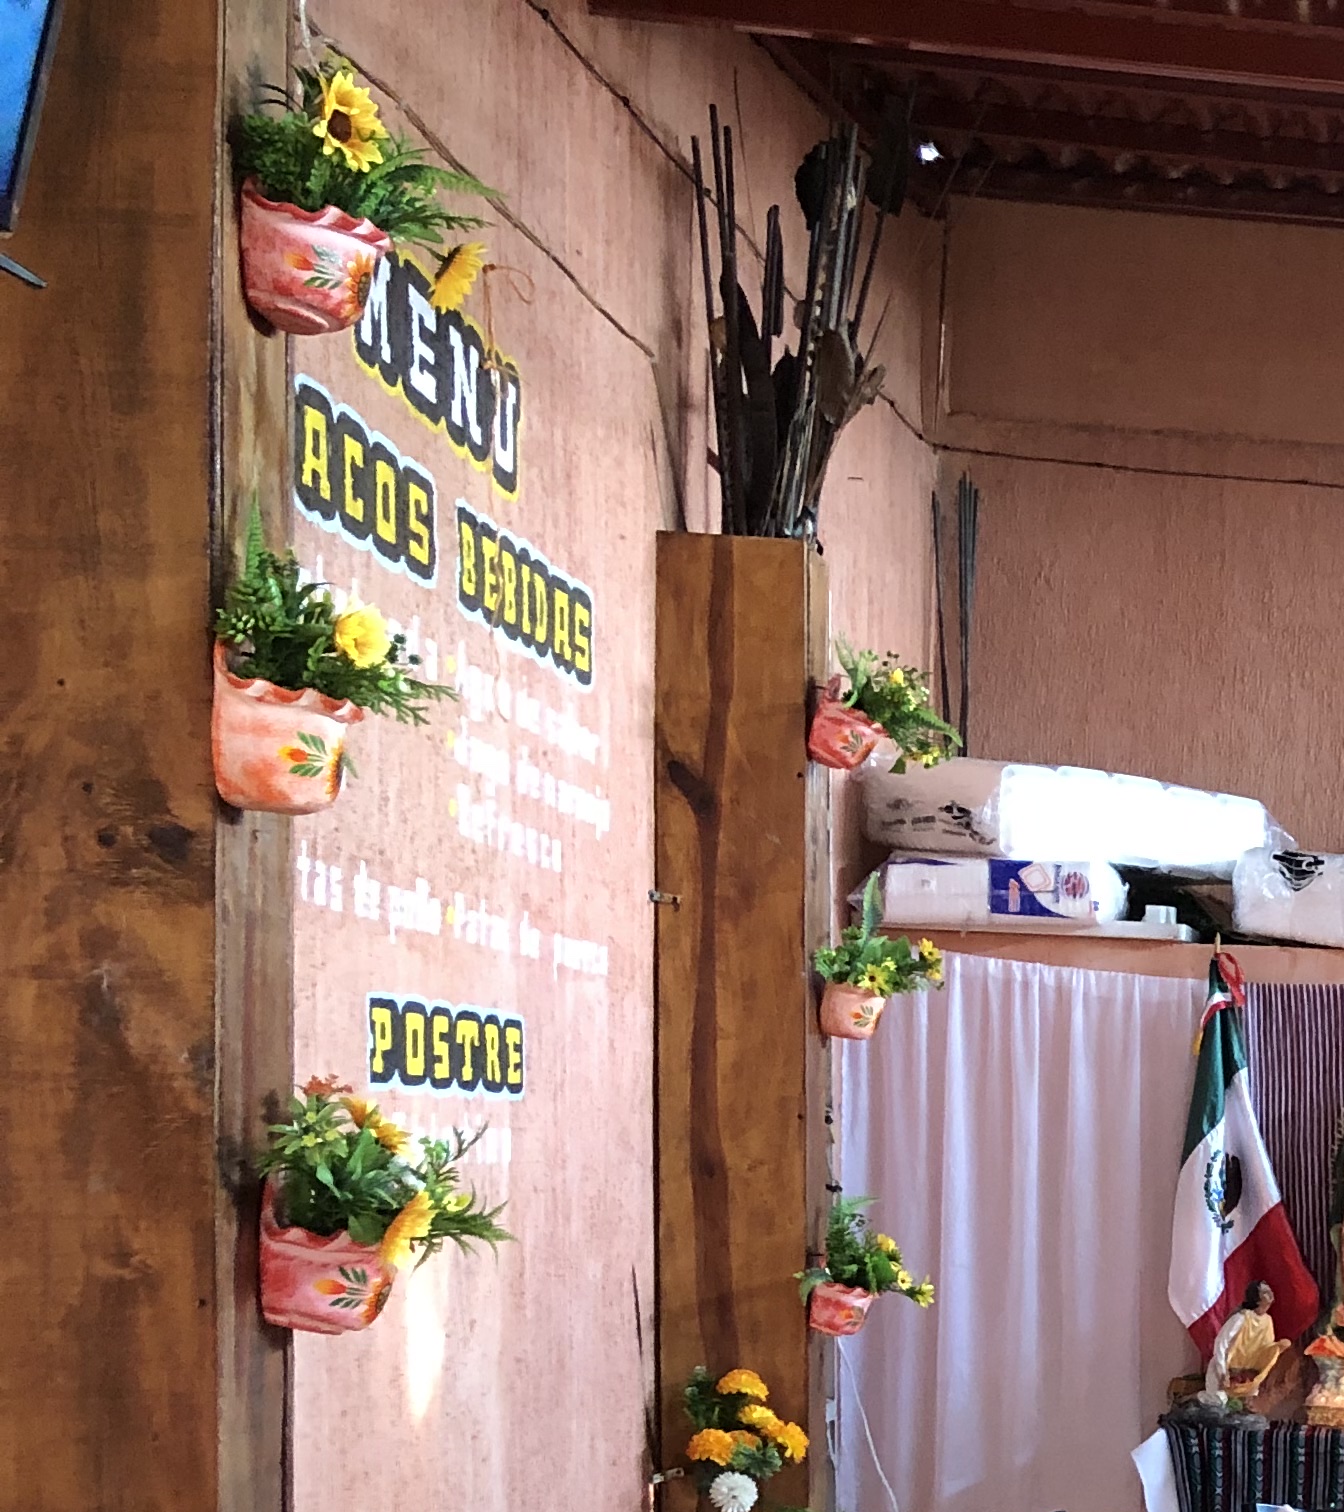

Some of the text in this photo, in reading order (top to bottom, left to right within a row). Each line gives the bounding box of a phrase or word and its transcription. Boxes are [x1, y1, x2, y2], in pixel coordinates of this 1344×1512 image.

[300, 402, 431, 568] ACOS
[459, 518, 592, 675] BEBIDAS
[296, 839, 344, 912] tas
[353, 859, 381, 921] de
[368, 1004, 525, 1088] POSTRE
